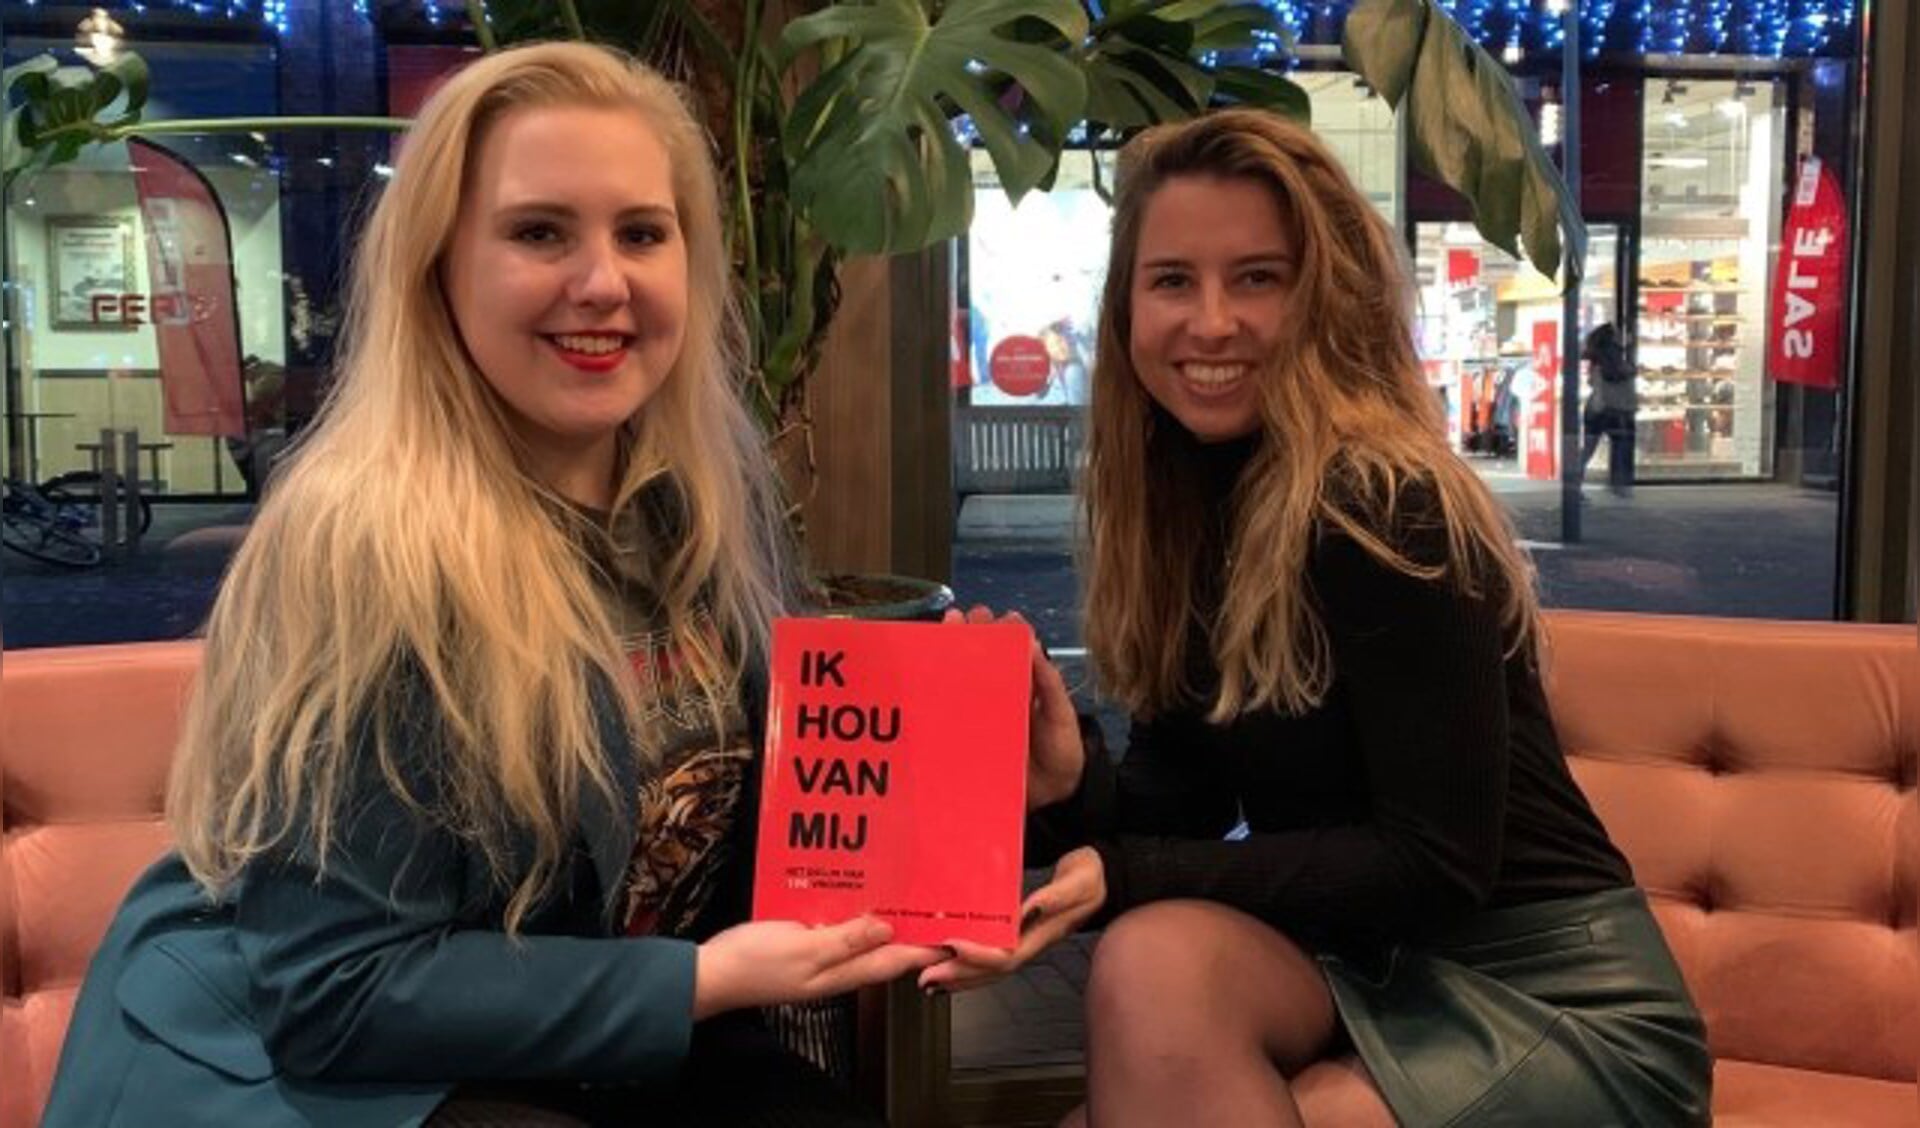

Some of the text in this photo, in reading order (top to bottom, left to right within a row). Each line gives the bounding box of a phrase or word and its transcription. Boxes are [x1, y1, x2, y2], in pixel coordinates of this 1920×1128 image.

[1529, 342, 1551, 454] SALE
[801, 650, 845, 688] IK
[797, 704, 901, 742] HOU
[793, 756, 889, 796] VAN
[788, 812, 867, 850] MIJ
